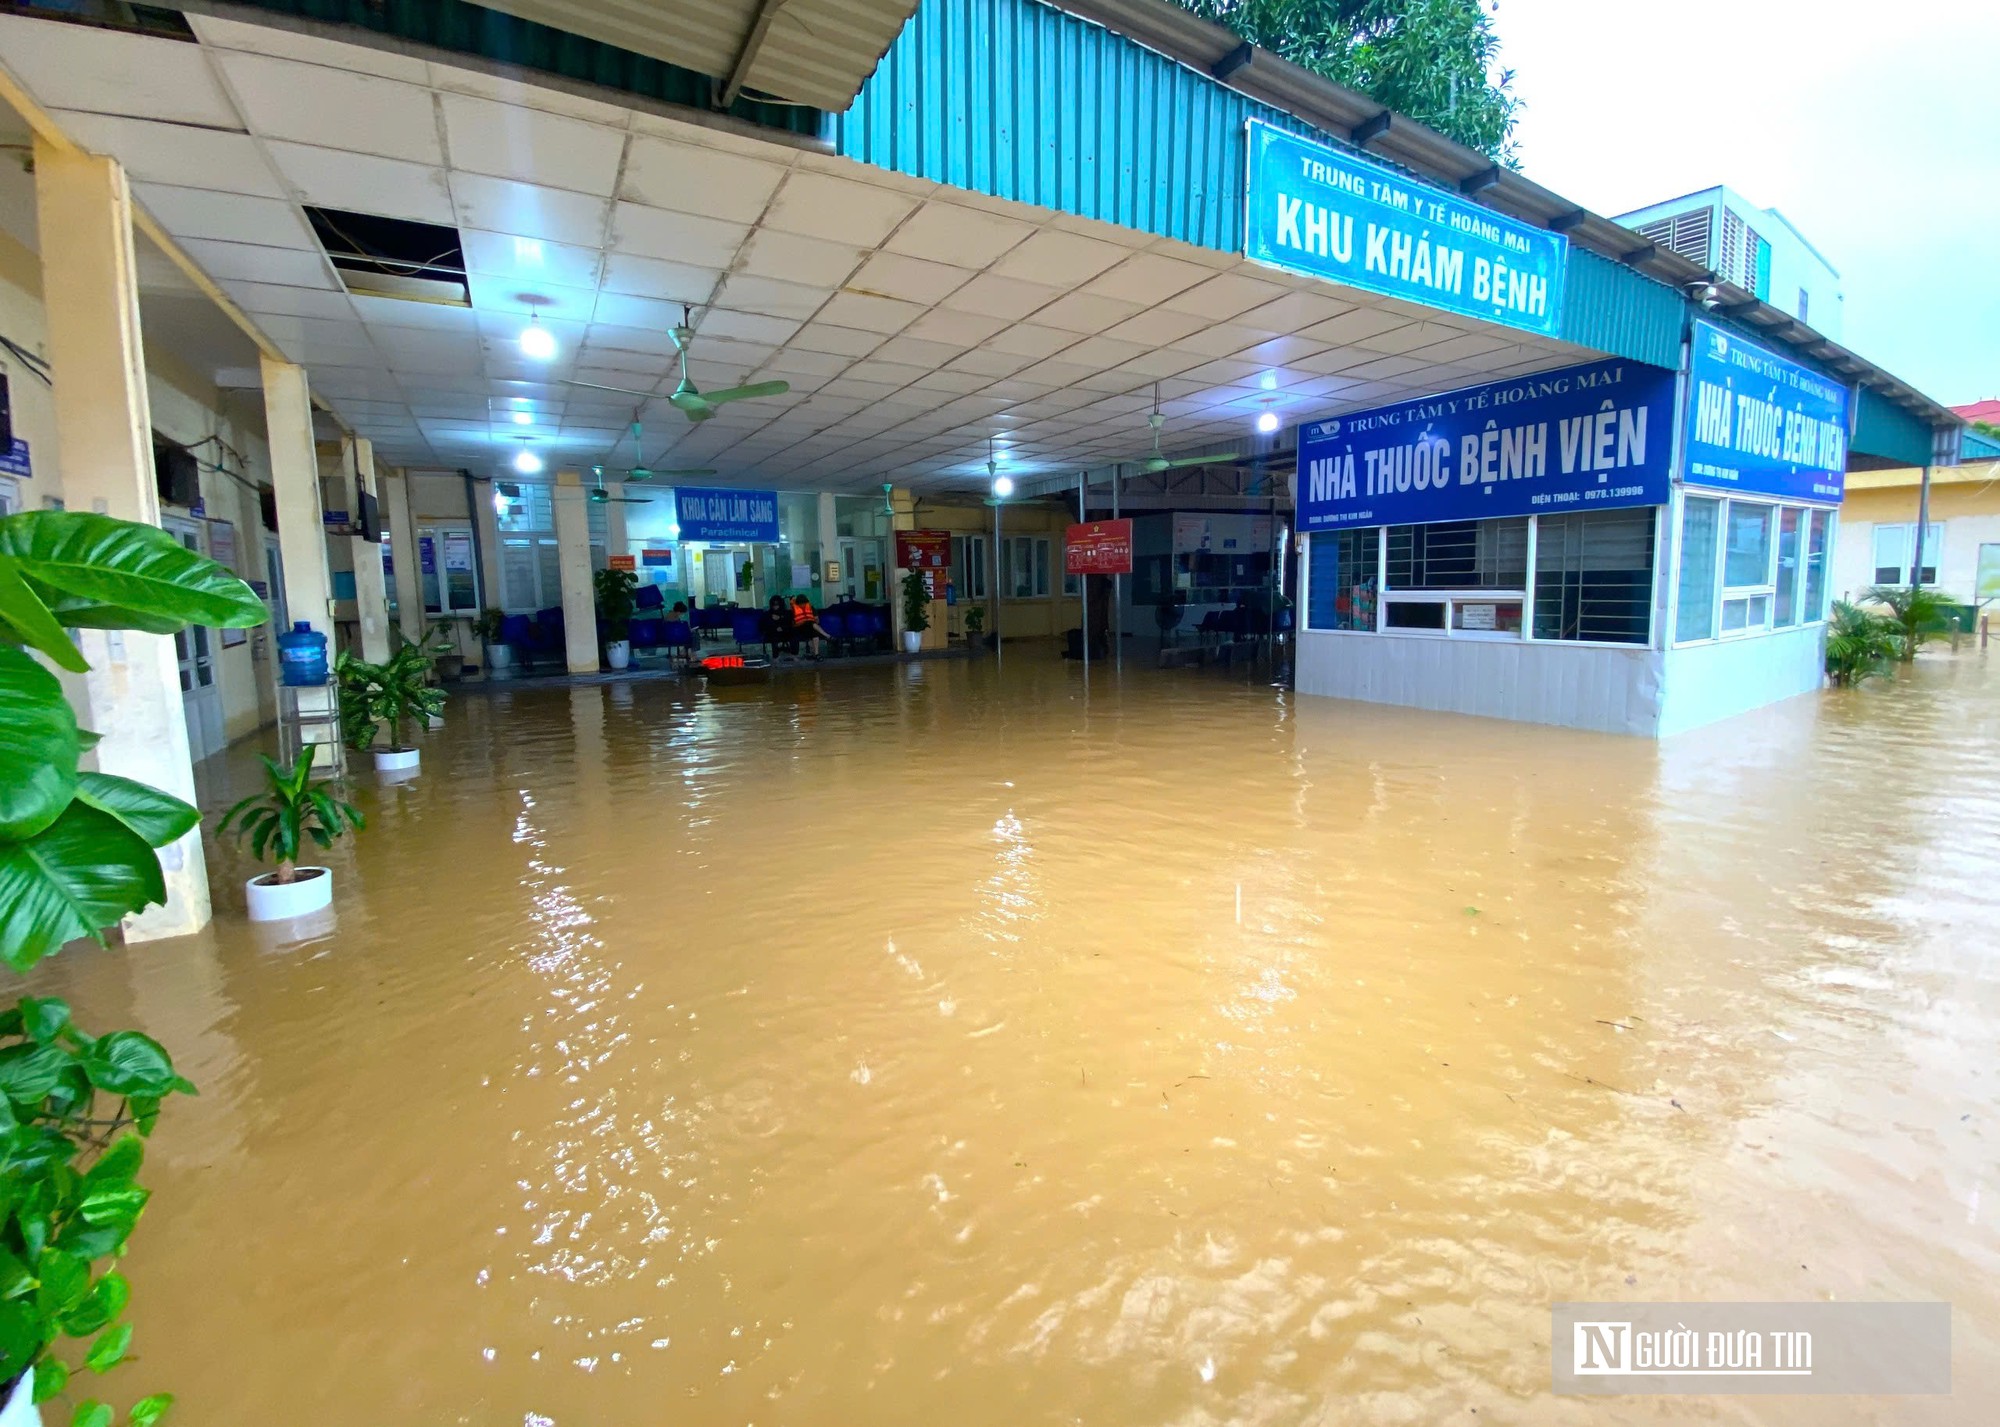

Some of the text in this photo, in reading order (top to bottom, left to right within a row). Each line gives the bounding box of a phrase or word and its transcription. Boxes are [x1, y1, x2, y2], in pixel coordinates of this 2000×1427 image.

[1301, 157, 1530, 253] TRUNG TÂM Y TẾ HOÀNG MAI
[1276, 193, 1547, 317] KHU KHÁM BỆNH
[1347, 367, 1622, 433] TRUNG TÂM Y TẾ HOÀNG MAI
[1731, 348, 1760, 373] TRUNG
[1309, 399, 1648, 503] NHÀ THUỐC BỆNH VIỆN
[1695, 377, 1844, 480] NHÀ THUỐC BỆNH VIỆN
[682, 496, 707, 520] KHOA
[708, 493, 727, 527] CẬN
[729, 494, 748, 522] LÂM
[701, 527, 758, 537] Paraclinical
